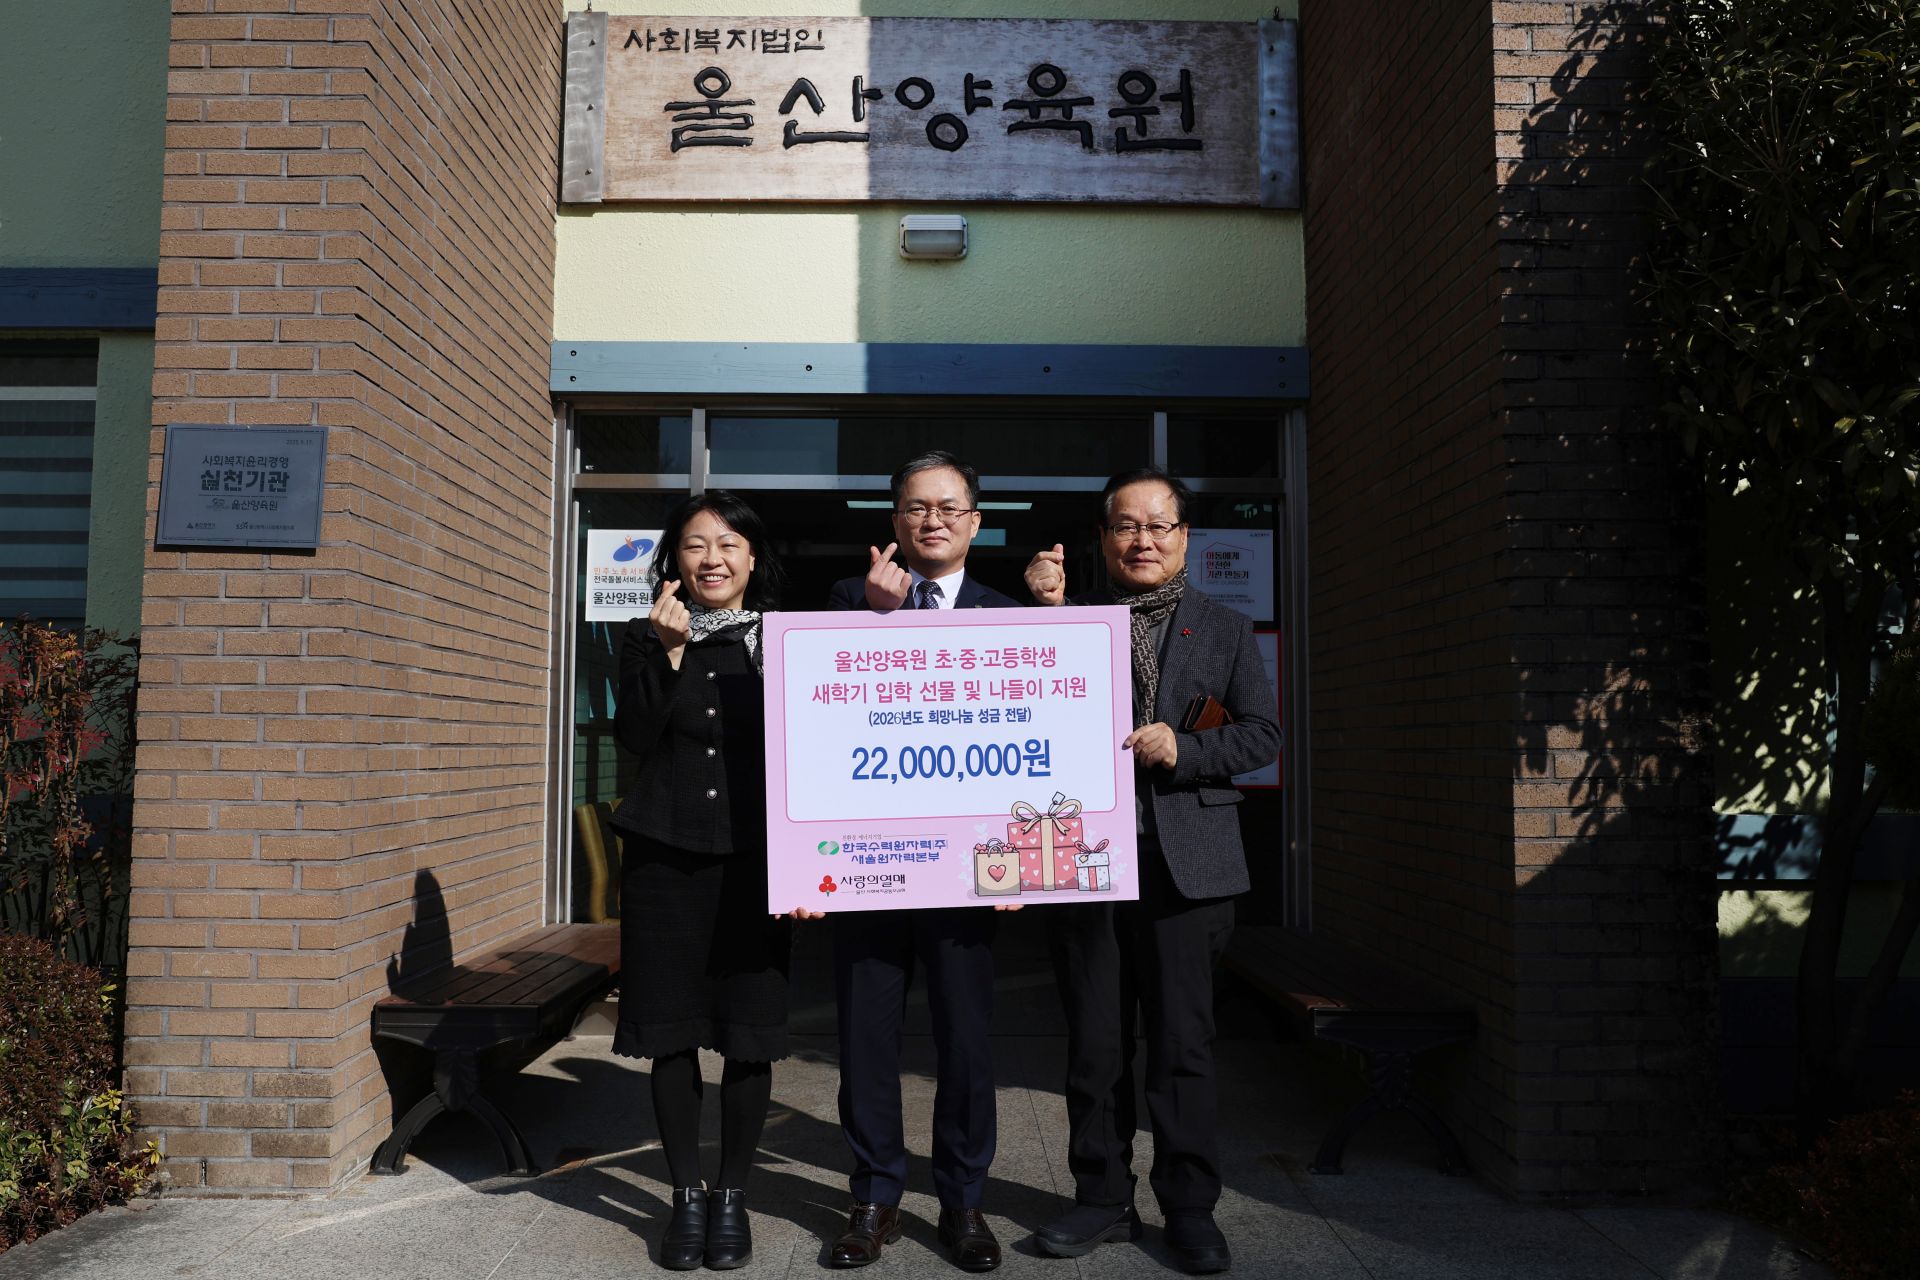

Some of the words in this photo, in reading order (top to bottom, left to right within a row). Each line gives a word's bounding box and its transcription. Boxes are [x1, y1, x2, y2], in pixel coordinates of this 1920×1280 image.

[624, 27, 825, 54] 사회복지법인
[664, 63, 1203, 153] 울산양육원
[202, 455, 289, 469] 사회복지윤리경영
[201, 469, 290, 493] 실천기관
[231, 499, 278, 511] 울산양육원
[834, 649, 927, 673] 울산양육원
[934, 647, 1056, 670] 초·중·고등학생
[812, 683, 867, 705] 새학기
[876, 682, 912, 703] 입학
[920, 680, 955, 702] 선물
[964, 680, 981, 701] 및
[989, 678, 1043, 700] 나들이
[1051, 677, 1087, 698] 지원
[868, 711, 924, 726] (2026년도
[928, 710, 973, 725] 희망나눔
[978, 708, 1001, 723] 성금
[1005, 707, 1032, 723] 전달)
[852, 739, 1051, 784] 22,000,000원
[851, 852, 940, 865] 새울원자력본부
[840, 874, 906, 889] 사랑의열매
